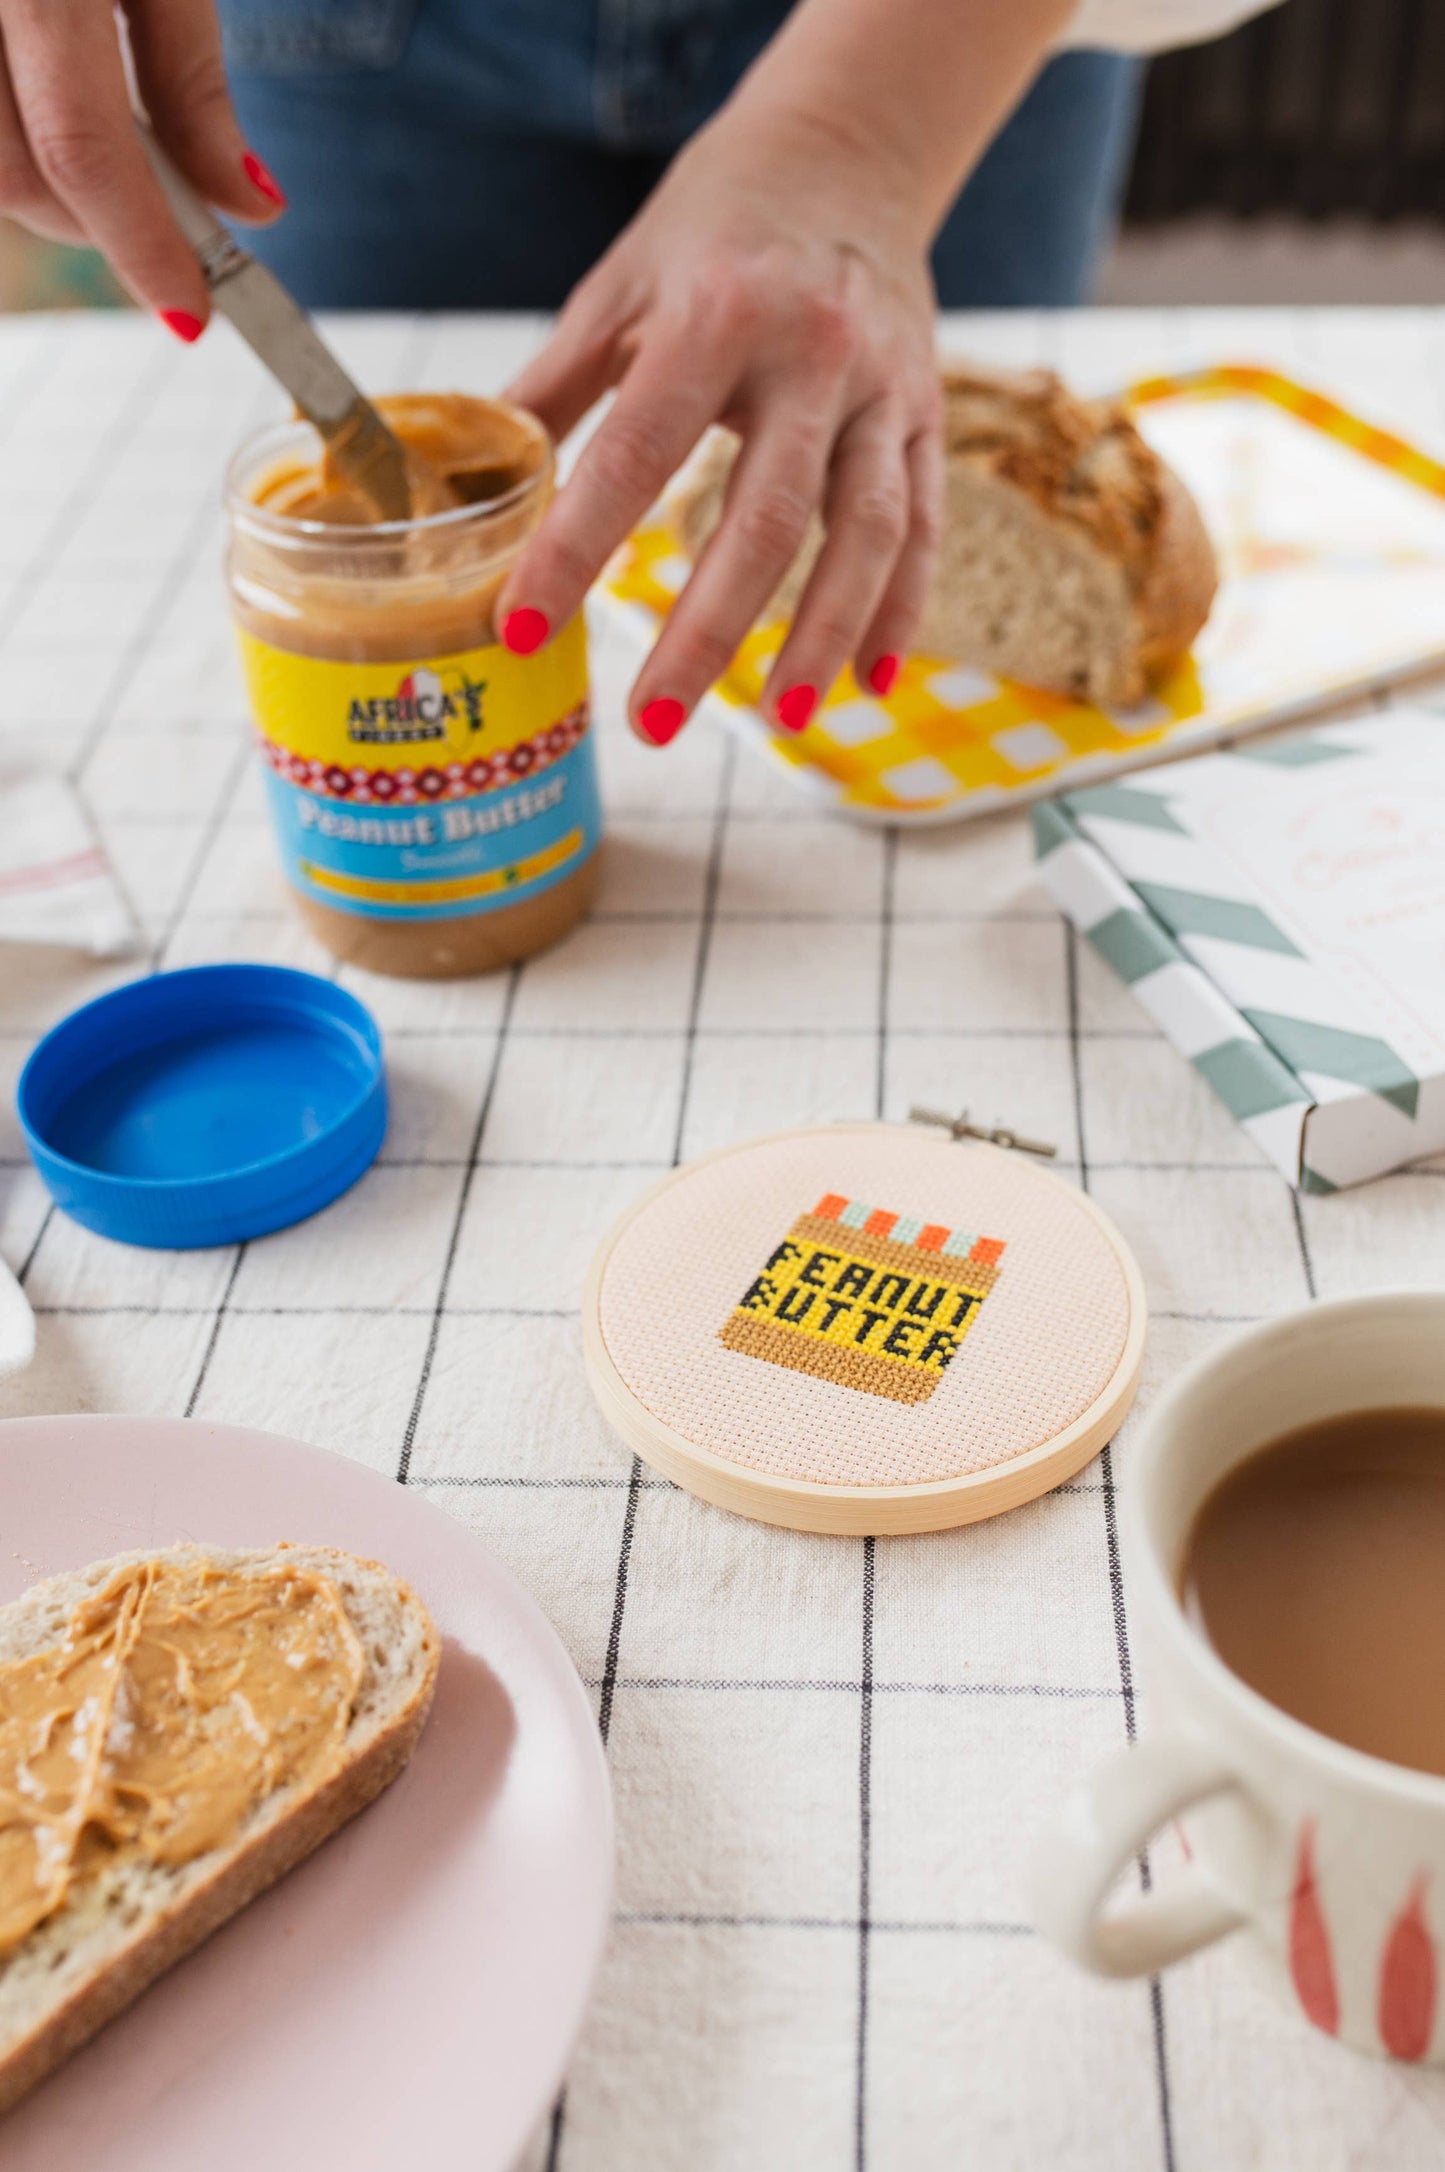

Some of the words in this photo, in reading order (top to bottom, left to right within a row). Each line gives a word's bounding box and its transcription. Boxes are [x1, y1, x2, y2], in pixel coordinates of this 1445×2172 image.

[297, 796, 436, 847] Peanut
[443, 776, 567, 842] Butter
[740, 1276, 961, 1368] BUTTER
[766, 1242, 985, 1328] PEANUT
